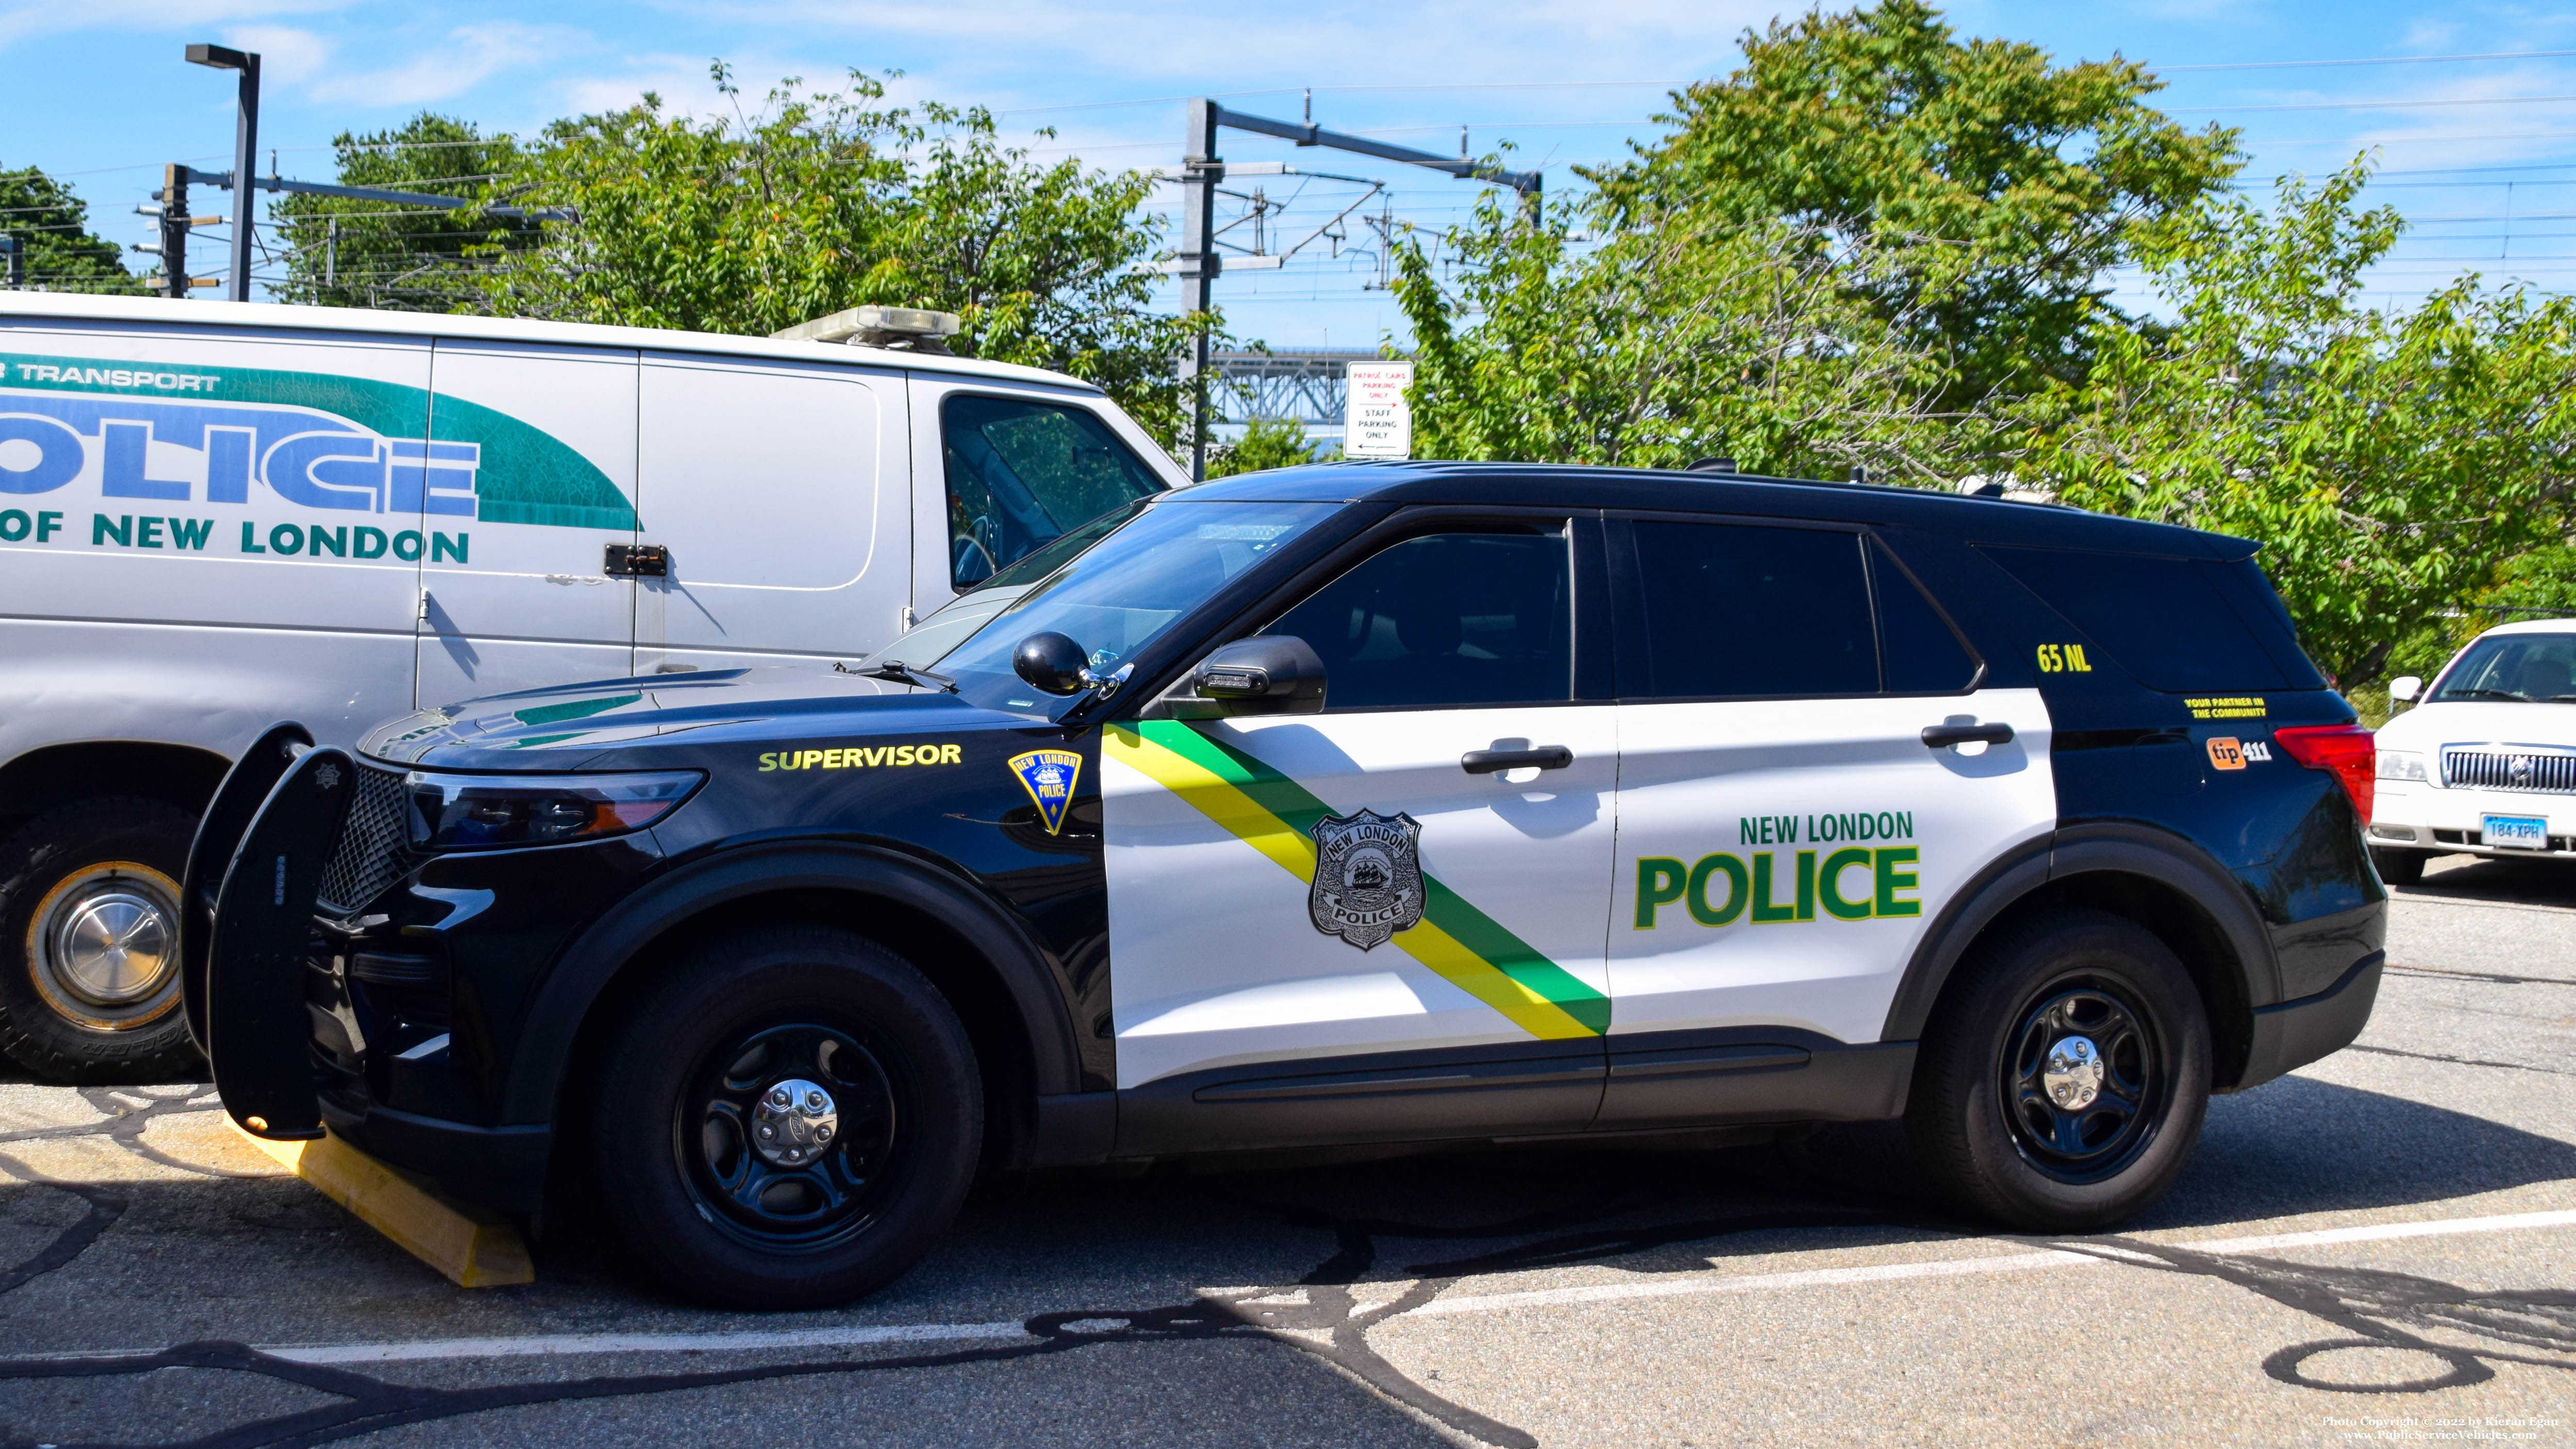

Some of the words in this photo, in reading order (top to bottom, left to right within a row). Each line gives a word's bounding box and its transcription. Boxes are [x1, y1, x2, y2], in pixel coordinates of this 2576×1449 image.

[19, 363, 220, 391] TRANSPORT
[0, 508, 63, 543] OF
[92, 514, 214, 551] NEW
[241, 521, 469, 564] LONDON
[2037, 644, 2063, 672] 65
[2064, 644, 2092, 672] NL
[2184, 698, 2211, 708] YOUR
[2211, 698, 2253, 706] PARTNER
[2252, 698, 2265, 706] IN
[2191, 709, 2211, 718] THE
[2211, 707, 2266, 718] COMMUNITY
[758, 744, 962, 771] SUPERVISOR
[1015, 756, 1036, 772] NEW
[1039, 754, 1076, 768] LONDON
[1038, 783, 1066, 798] POLICE
[1740, 815, 1799, 845] NEW
[1808, 811, 1913, 842] LONDON
[1328, 833, 1353, 858] NEW
[1357, 826, 1407, 852] LONDON
[1633, 845, 1922, 931] POLICE
[1334, 903, 1402, 925] POLICE
